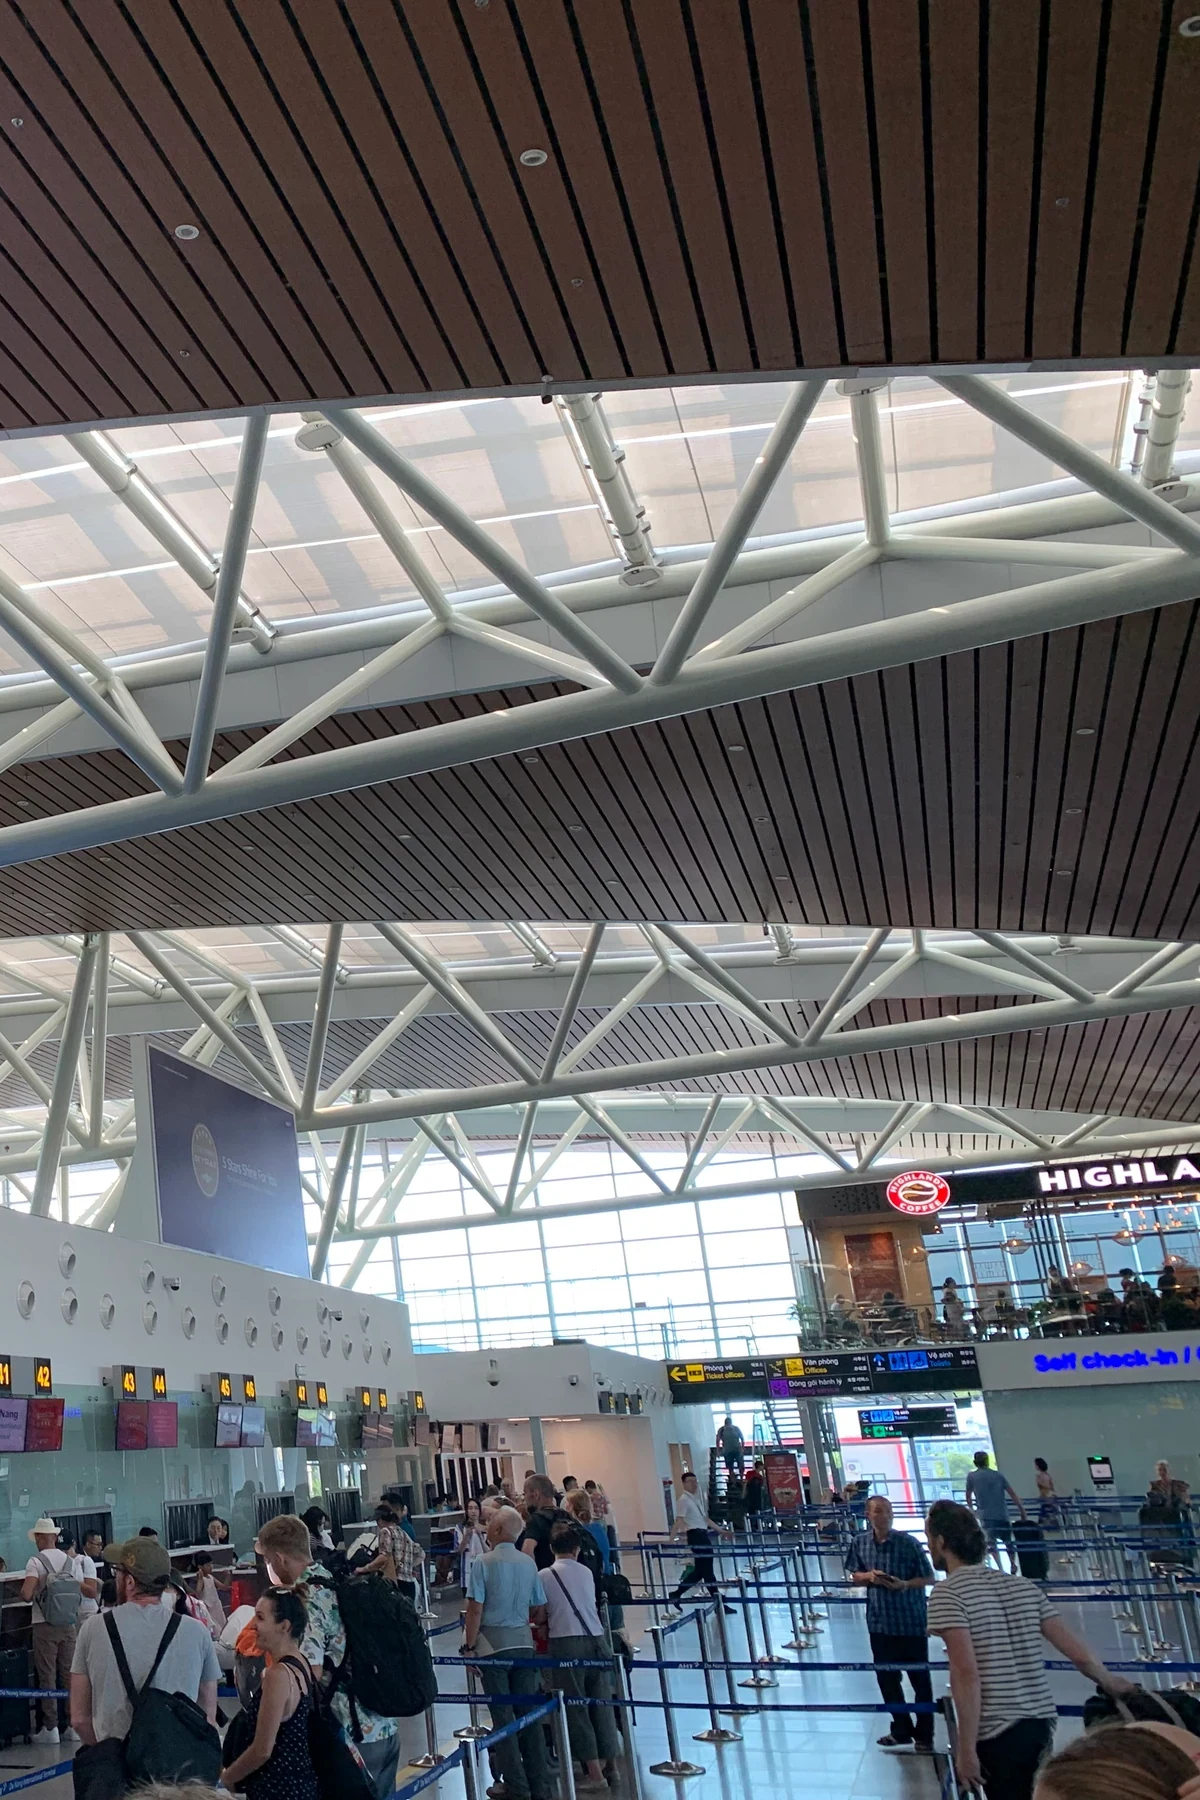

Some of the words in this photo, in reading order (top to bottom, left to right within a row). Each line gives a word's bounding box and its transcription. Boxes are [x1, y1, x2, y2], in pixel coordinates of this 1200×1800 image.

[890, 1173, 946, 1193] HIGHLANDS
[1038, 1158, 1200, 1192] HIGHLA
[900, 1199, 942, 1212] COFFEE
[818, 1358, 839, 1366] phòng
[928, 1351, 938, 1360] Vệ
[1034, 1352, 1077, 1373] Self
[1082, 1348, 1179, 1369] check-in
[704, 1364, 724, 1372] Phòng
[725, 1371, 745, 1379] offices
[37, 1366, 50, 1387] 42
[123, 1372, 135, 1392] 43
[154, 1375, 165, 1393] 44
[220, 1379, 230, 1396] 45
[245, 1381, 255, 1397] 46
[298, 1386, 306, 1401] 47
[0, 1409, 19, 1421] Nang
